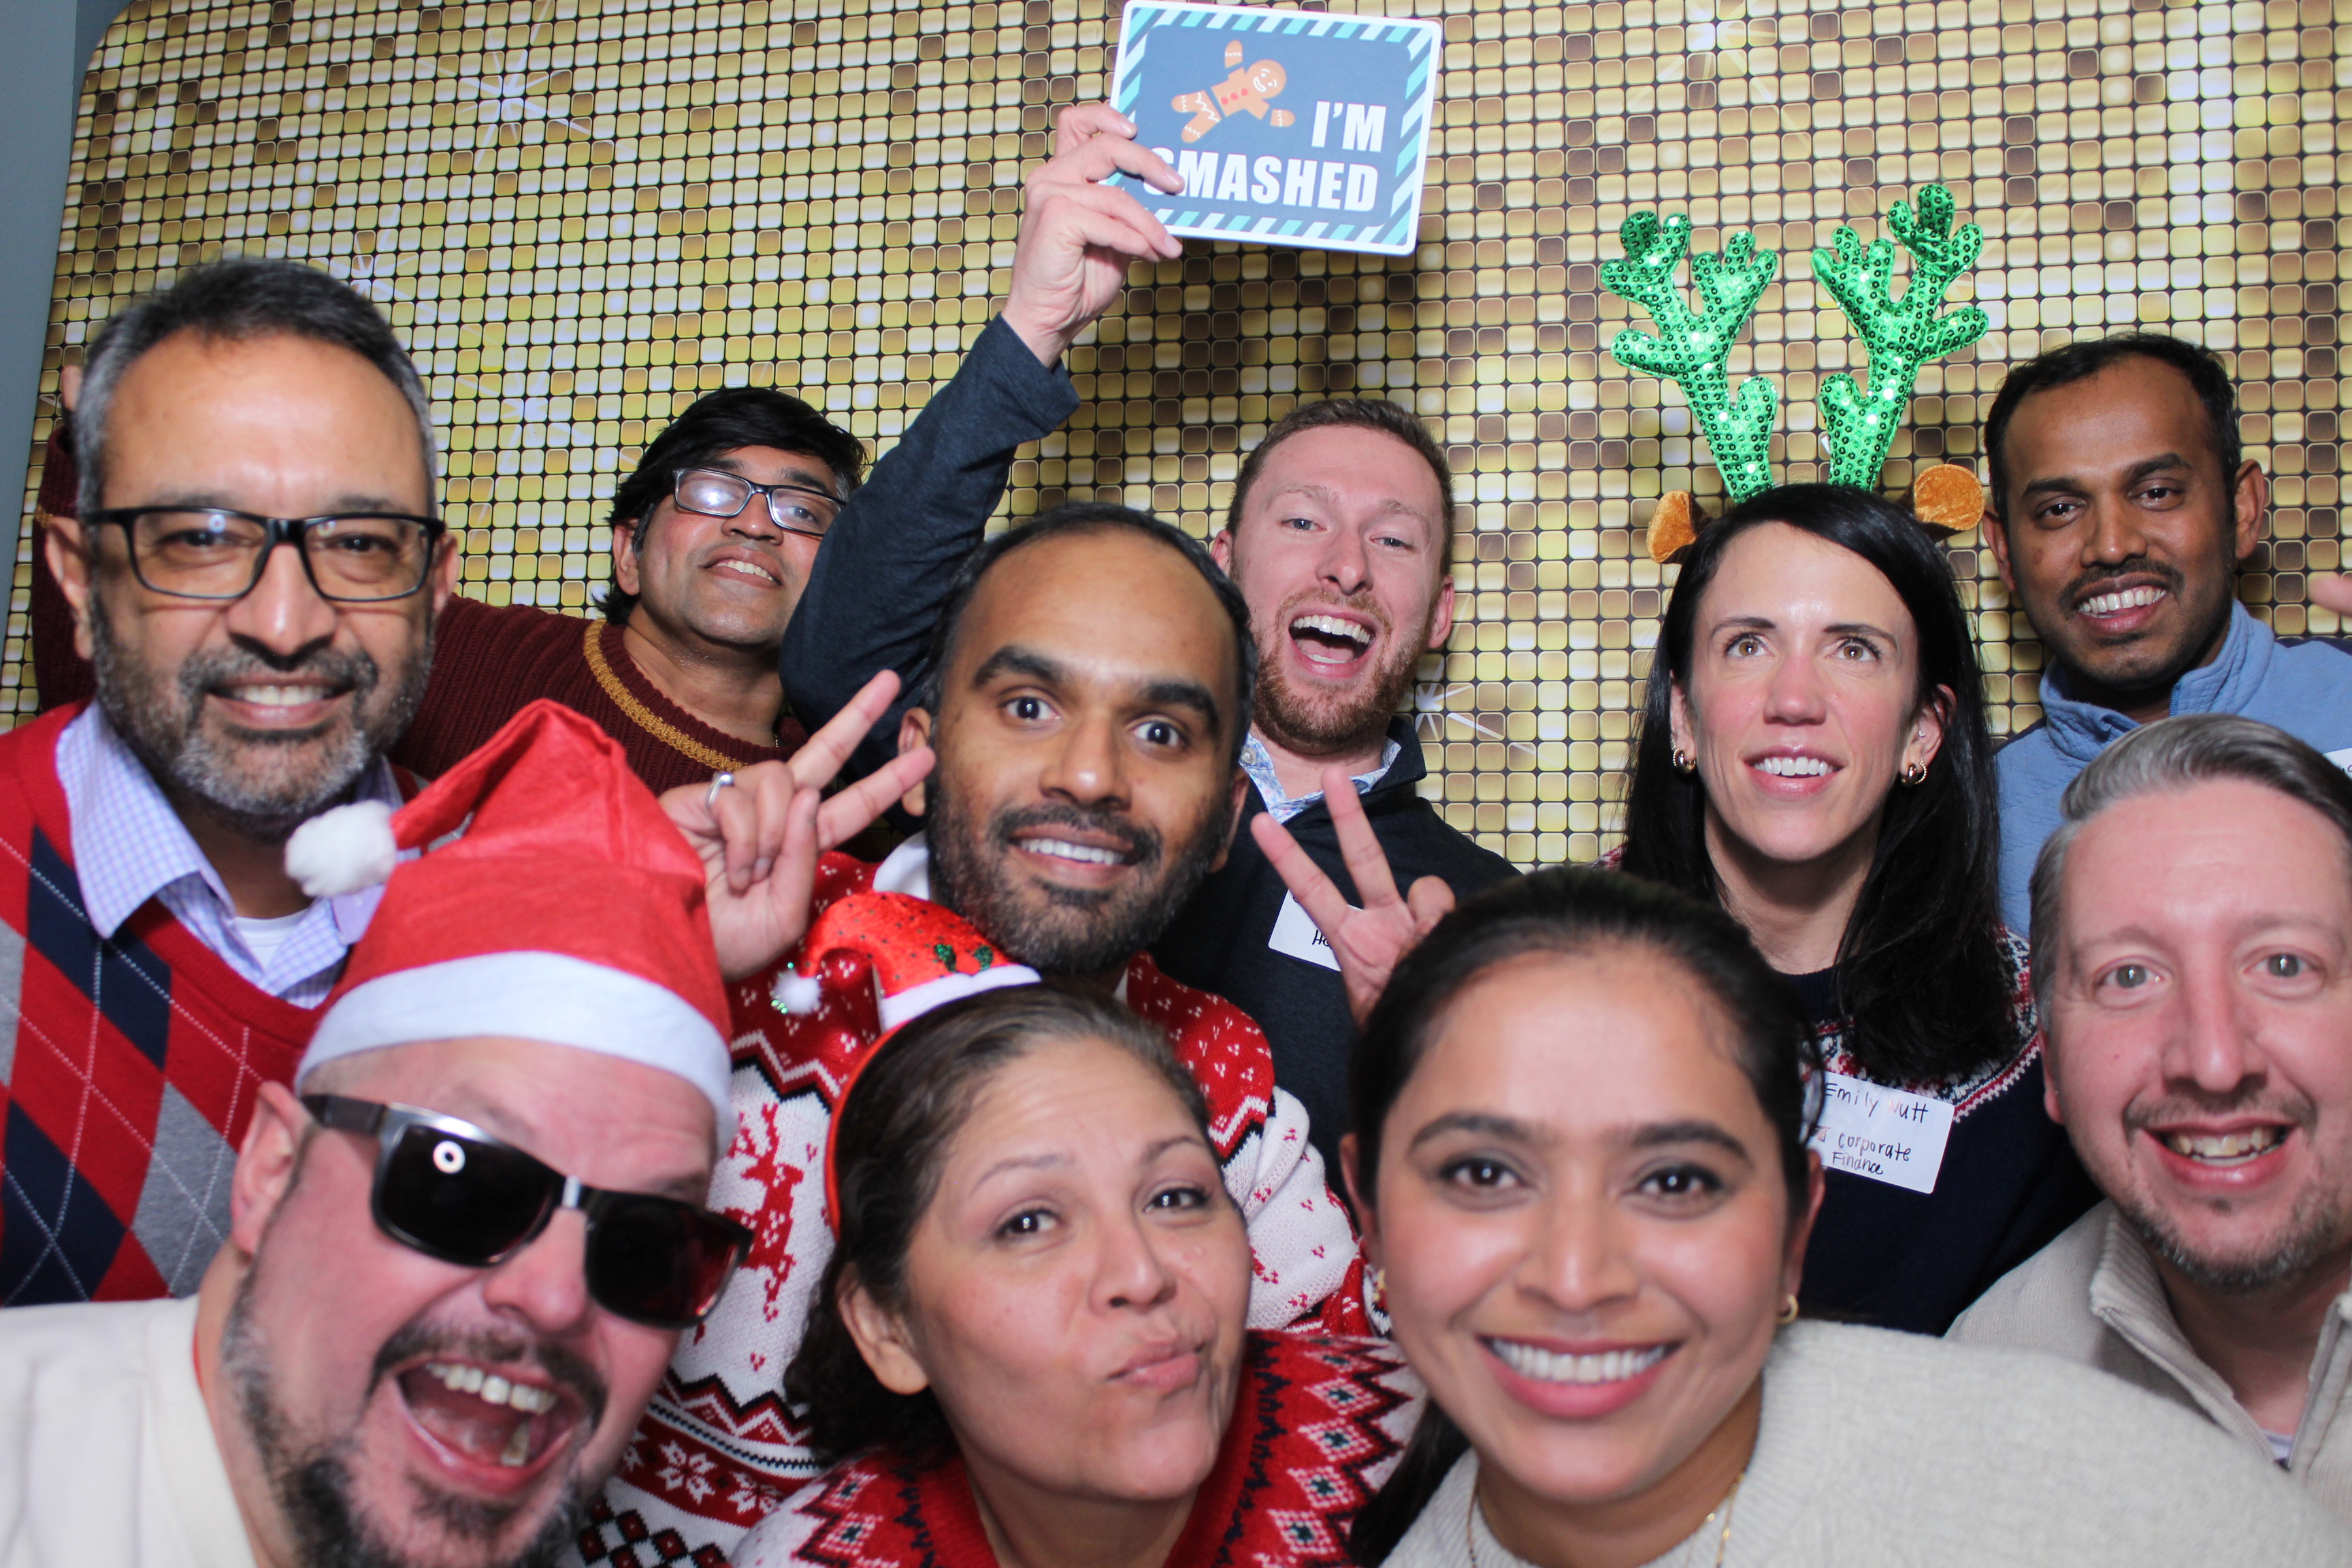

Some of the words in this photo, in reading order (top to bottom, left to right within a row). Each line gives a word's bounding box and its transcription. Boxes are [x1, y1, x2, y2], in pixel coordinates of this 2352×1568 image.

[1311, 100, 1386, 152] I'M
[1825, 1082, 1878, 1117] Emily
[1832, 1151, 1883, 1175] Finance
